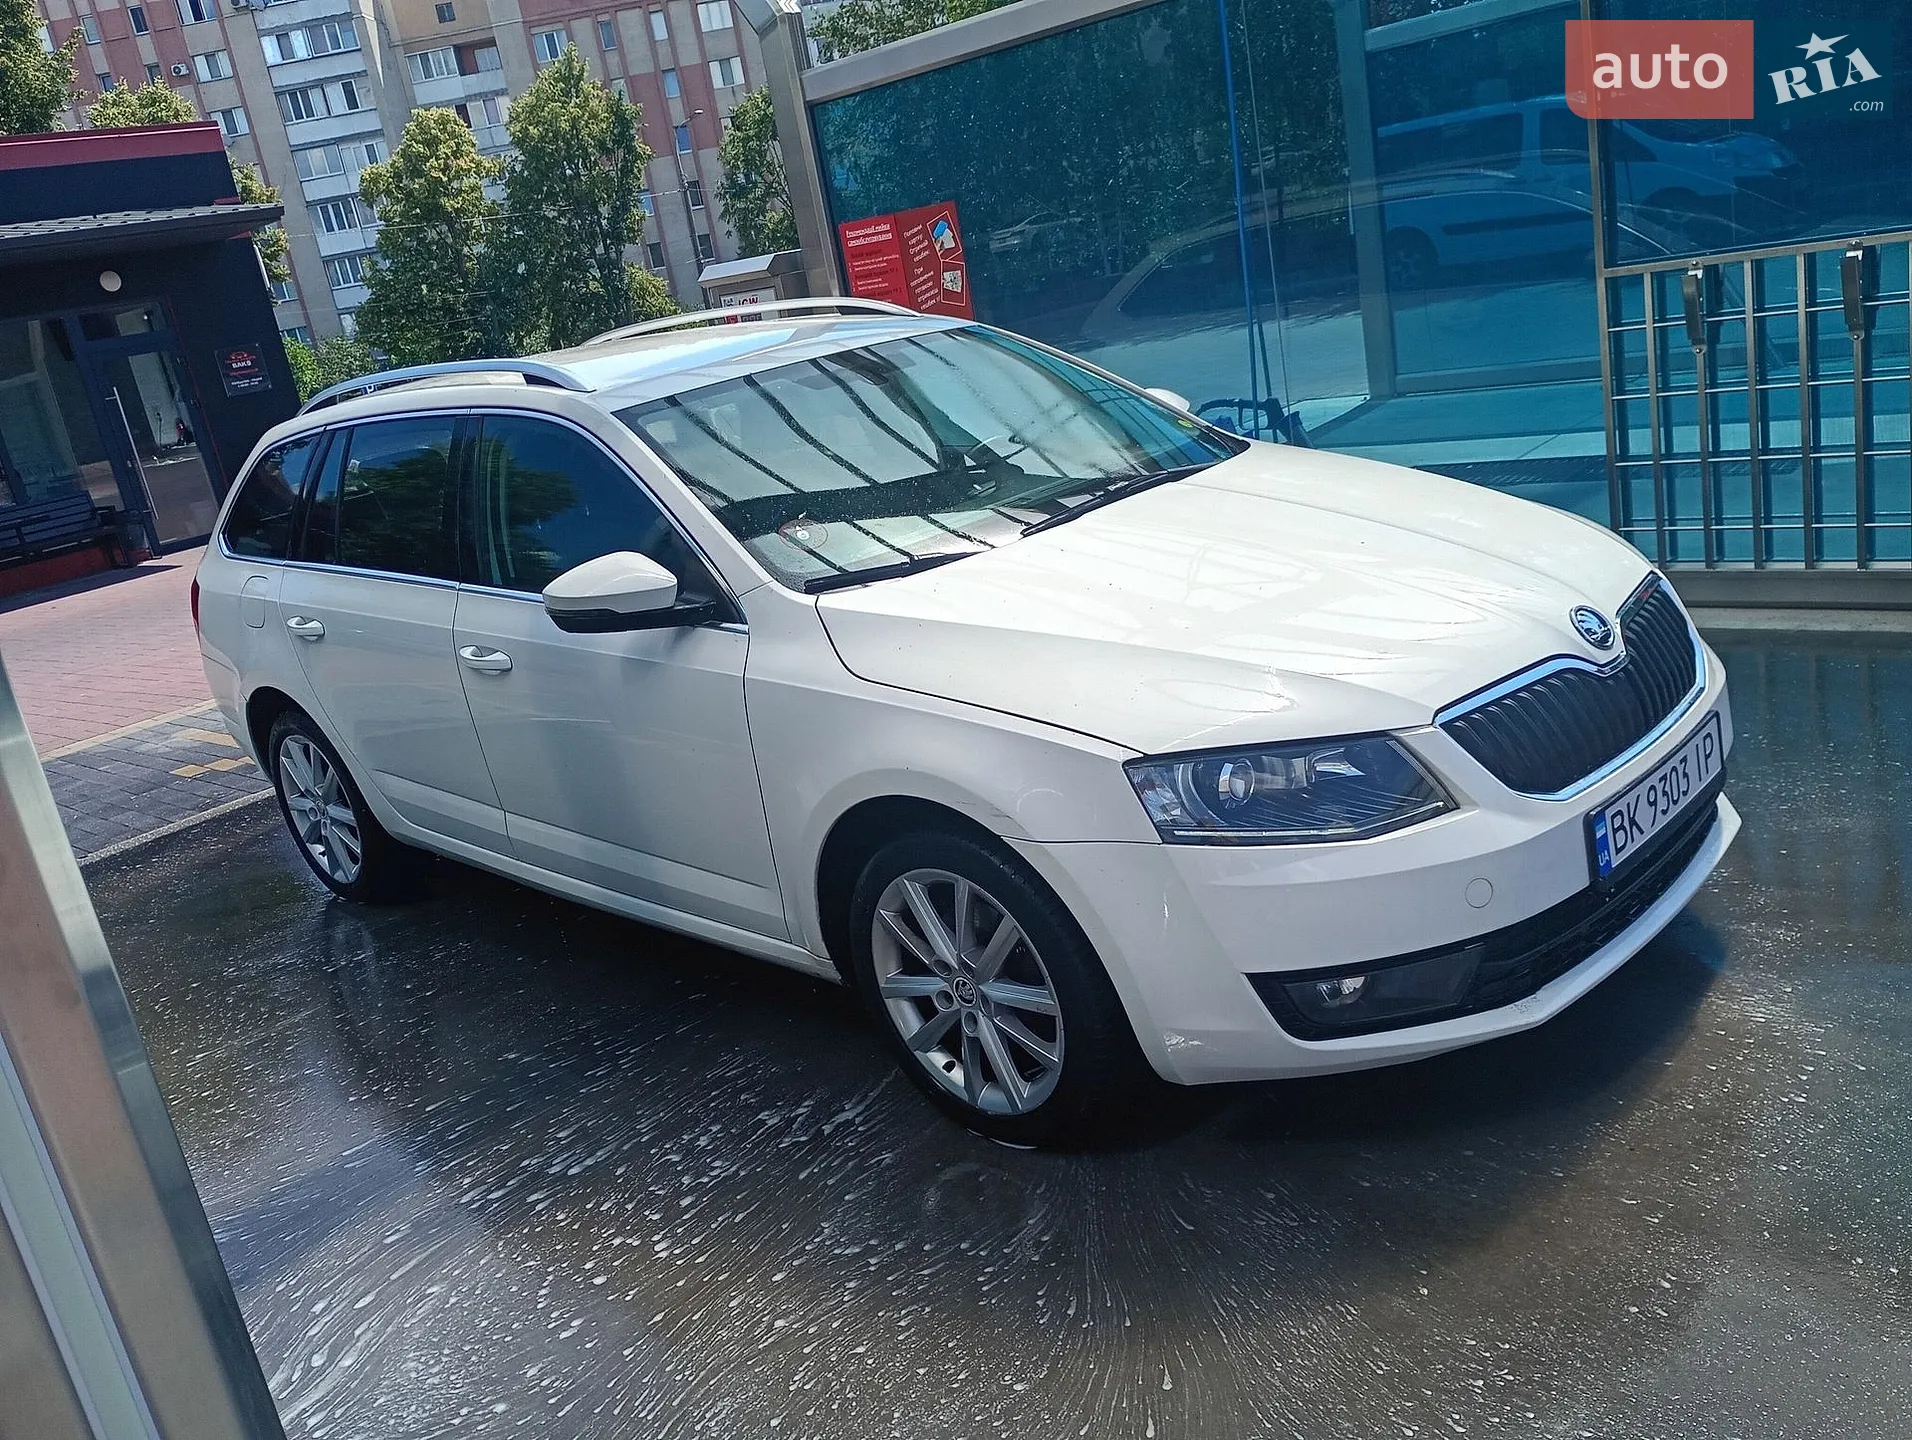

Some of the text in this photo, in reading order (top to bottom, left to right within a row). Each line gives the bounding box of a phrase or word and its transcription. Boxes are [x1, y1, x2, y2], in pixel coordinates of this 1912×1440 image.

[1610, 731, 1714, 857] BK 9303 IP
[1598, 849, 1610, 867] UA
